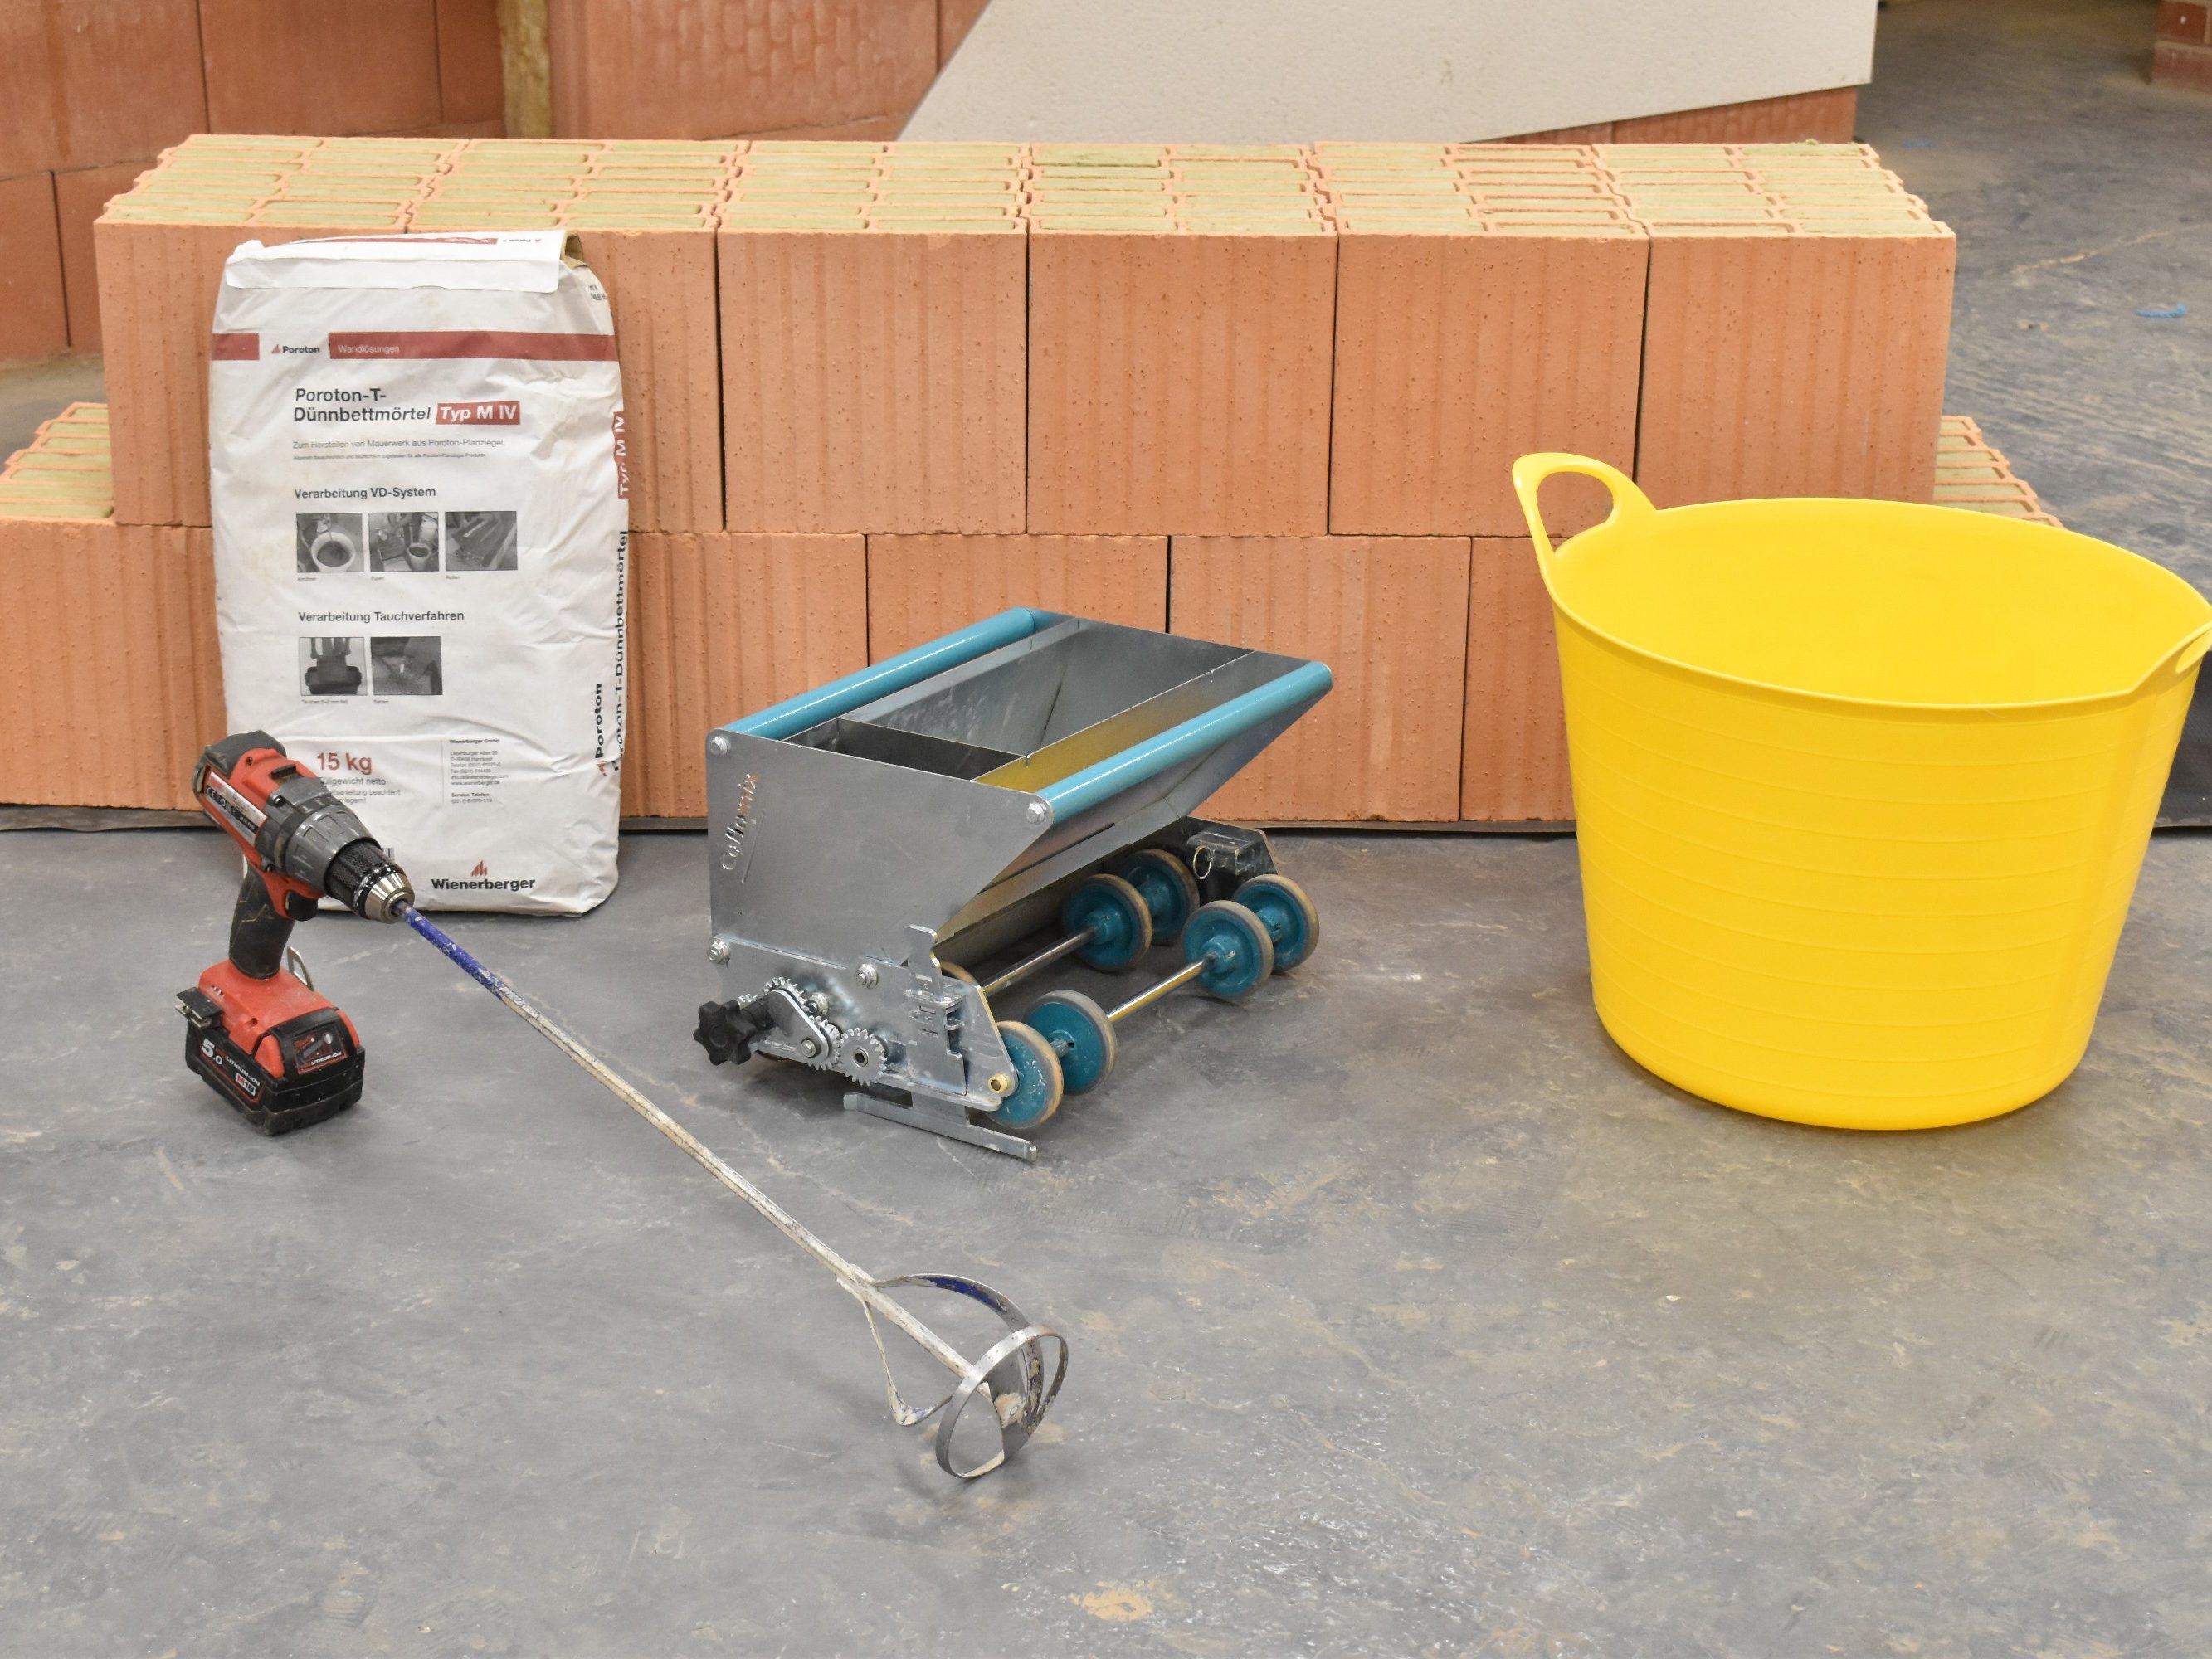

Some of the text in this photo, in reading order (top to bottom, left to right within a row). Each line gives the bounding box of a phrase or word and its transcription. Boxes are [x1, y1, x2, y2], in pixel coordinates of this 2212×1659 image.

[282, 344, 400, 356] Poroton Wandlösungen
[295, 388, 387, 402] Poroton-T-
[294, 405, 517, 422] Dünnbettmörtel Typ M IV
[311, 440, 349, 449] Herstellen
[295, 487, 436, 499] Verarbeitung VD-System
[298, 611, 465, 624] Verarbeitung Tauchverfahren
[594, 683, 605, 759] Poroton
[317, 752, 373, 776] 15 kg
[431, 878, 536, 892] Wienerberger
